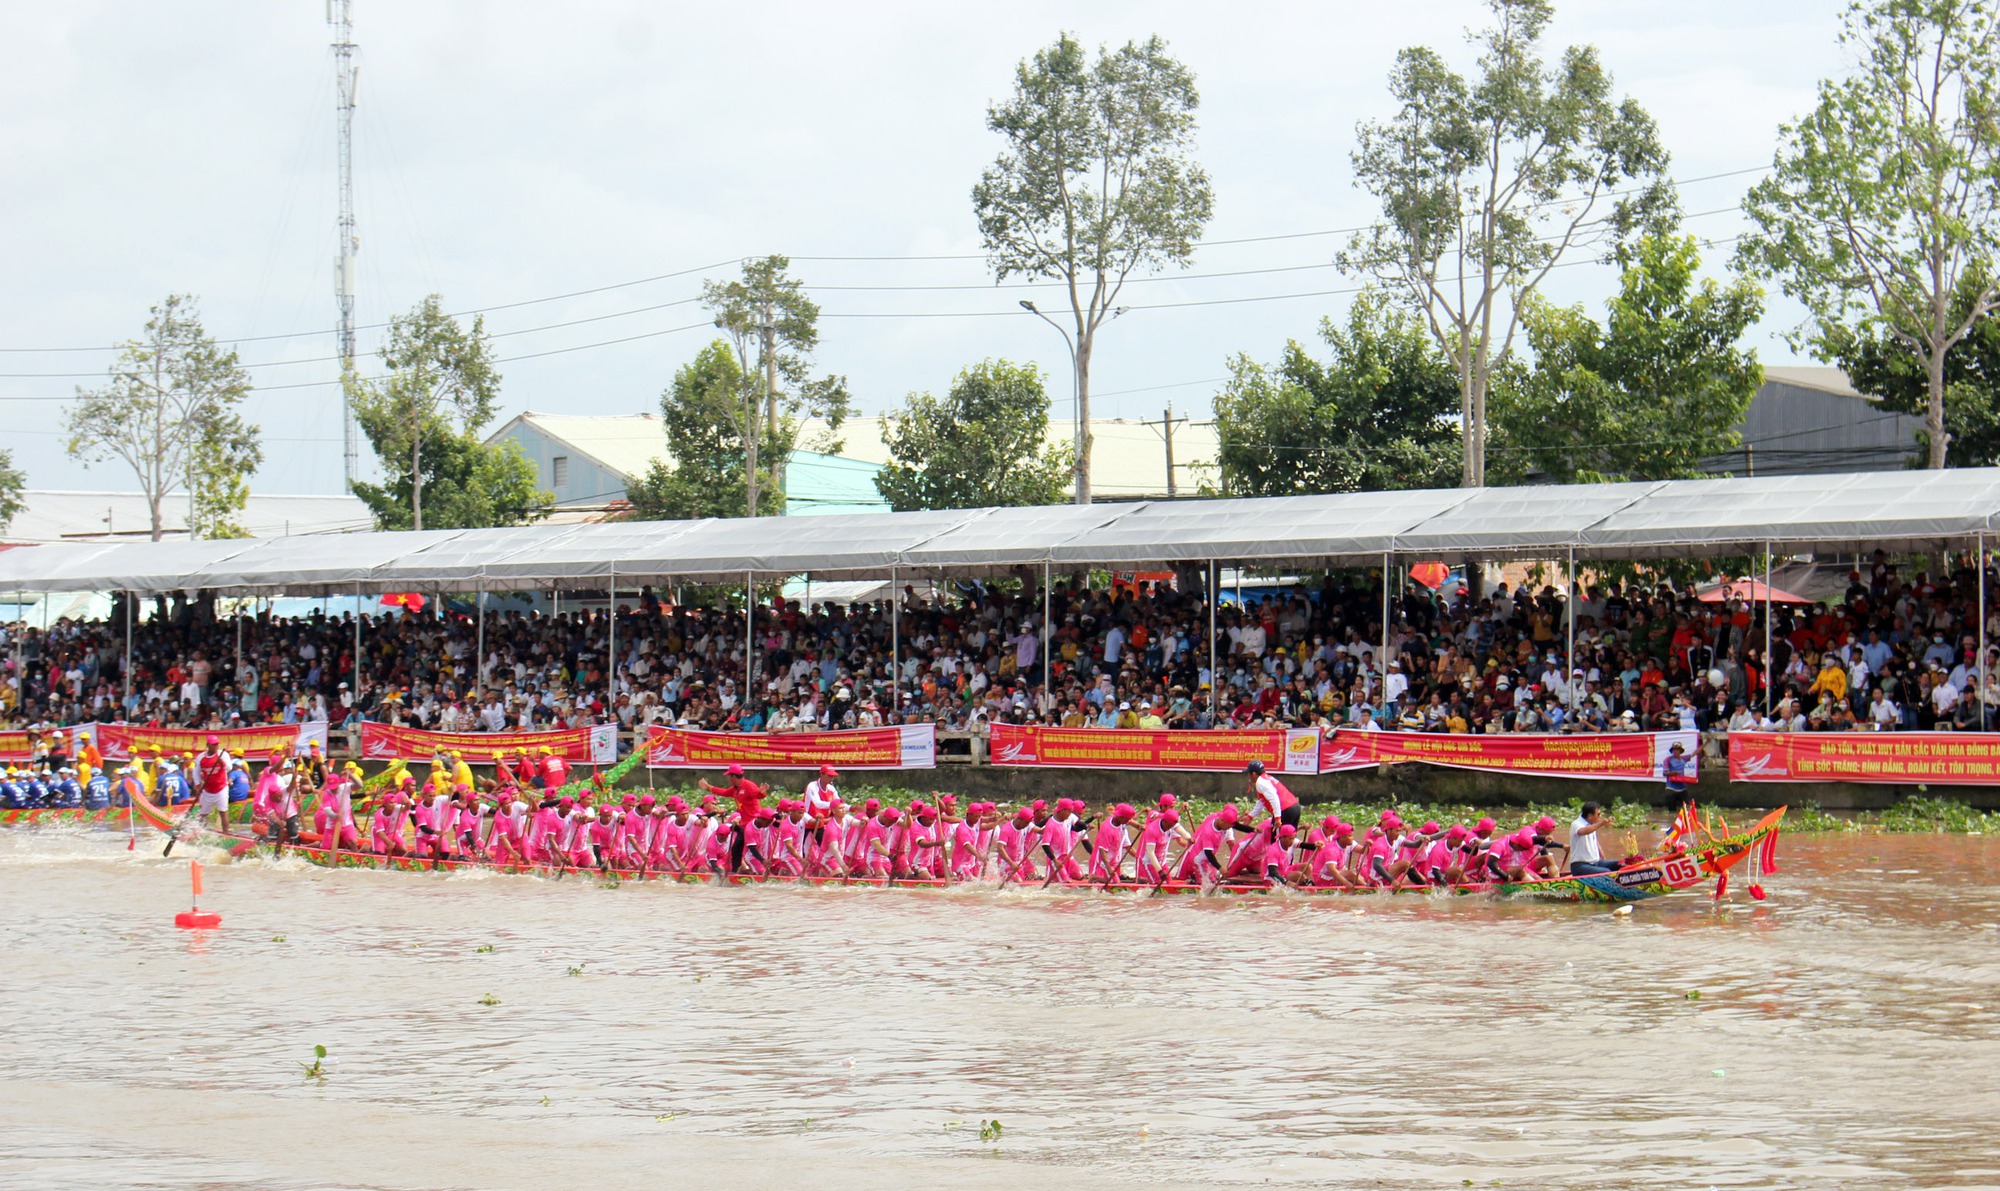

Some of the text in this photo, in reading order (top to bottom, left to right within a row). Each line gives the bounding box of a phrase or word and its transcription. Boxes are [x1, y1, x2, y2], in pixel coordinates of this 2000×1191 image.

[1821, 740, 1836, 755] BẢO
[1838, 740, 1855, 756] TỒN,
[1857, 741, 1876, 755] PHÁT
[1878, 743, 1893, 755] HUY
[1895, 740, 1911, 756] BẢN
[1913, 740, 1929, 756] SẮC
[1931, 742, 1947, 756] VĂN
[1816, 759, 1831, 772] SÓC
[1862, 759, 1880, 773] BÌNH
[1907, 760, 1929, 774] ĐOÀN
[1949, 761, 1964, 774] TÔN
[1666, 859, 1697, 882] 05
